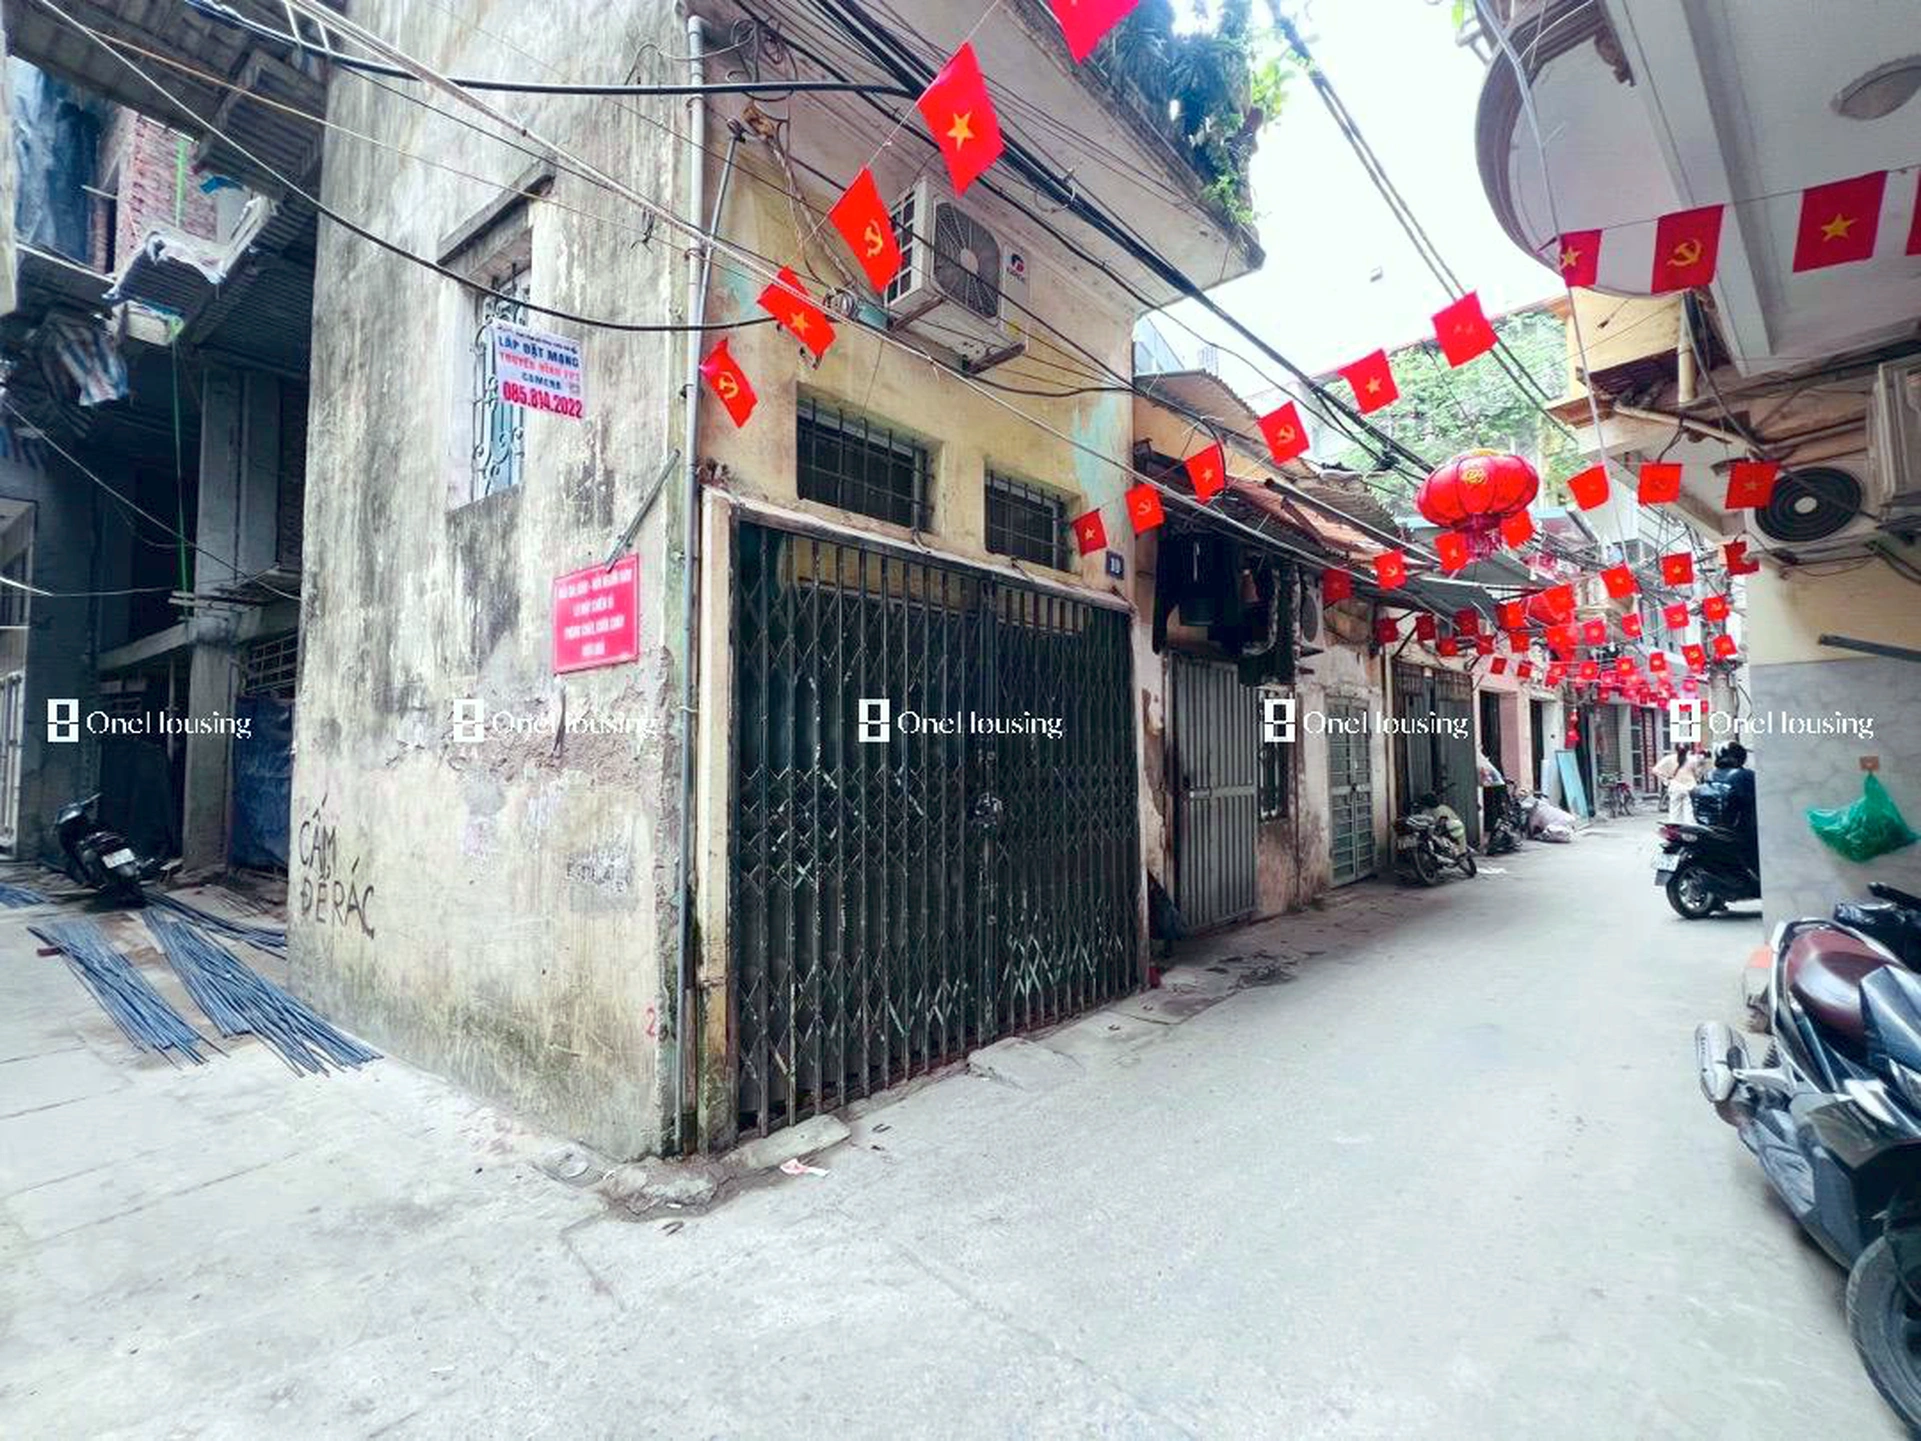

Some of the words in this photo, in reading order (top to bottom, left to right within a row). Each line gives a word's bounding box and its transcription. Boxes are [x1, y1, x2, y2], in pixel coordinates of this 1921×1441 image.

[299, 793, 337, 873] CẤM
[300, 866, 331, 924] ĐỂ
[333, 856, 375, 940] RÁC
